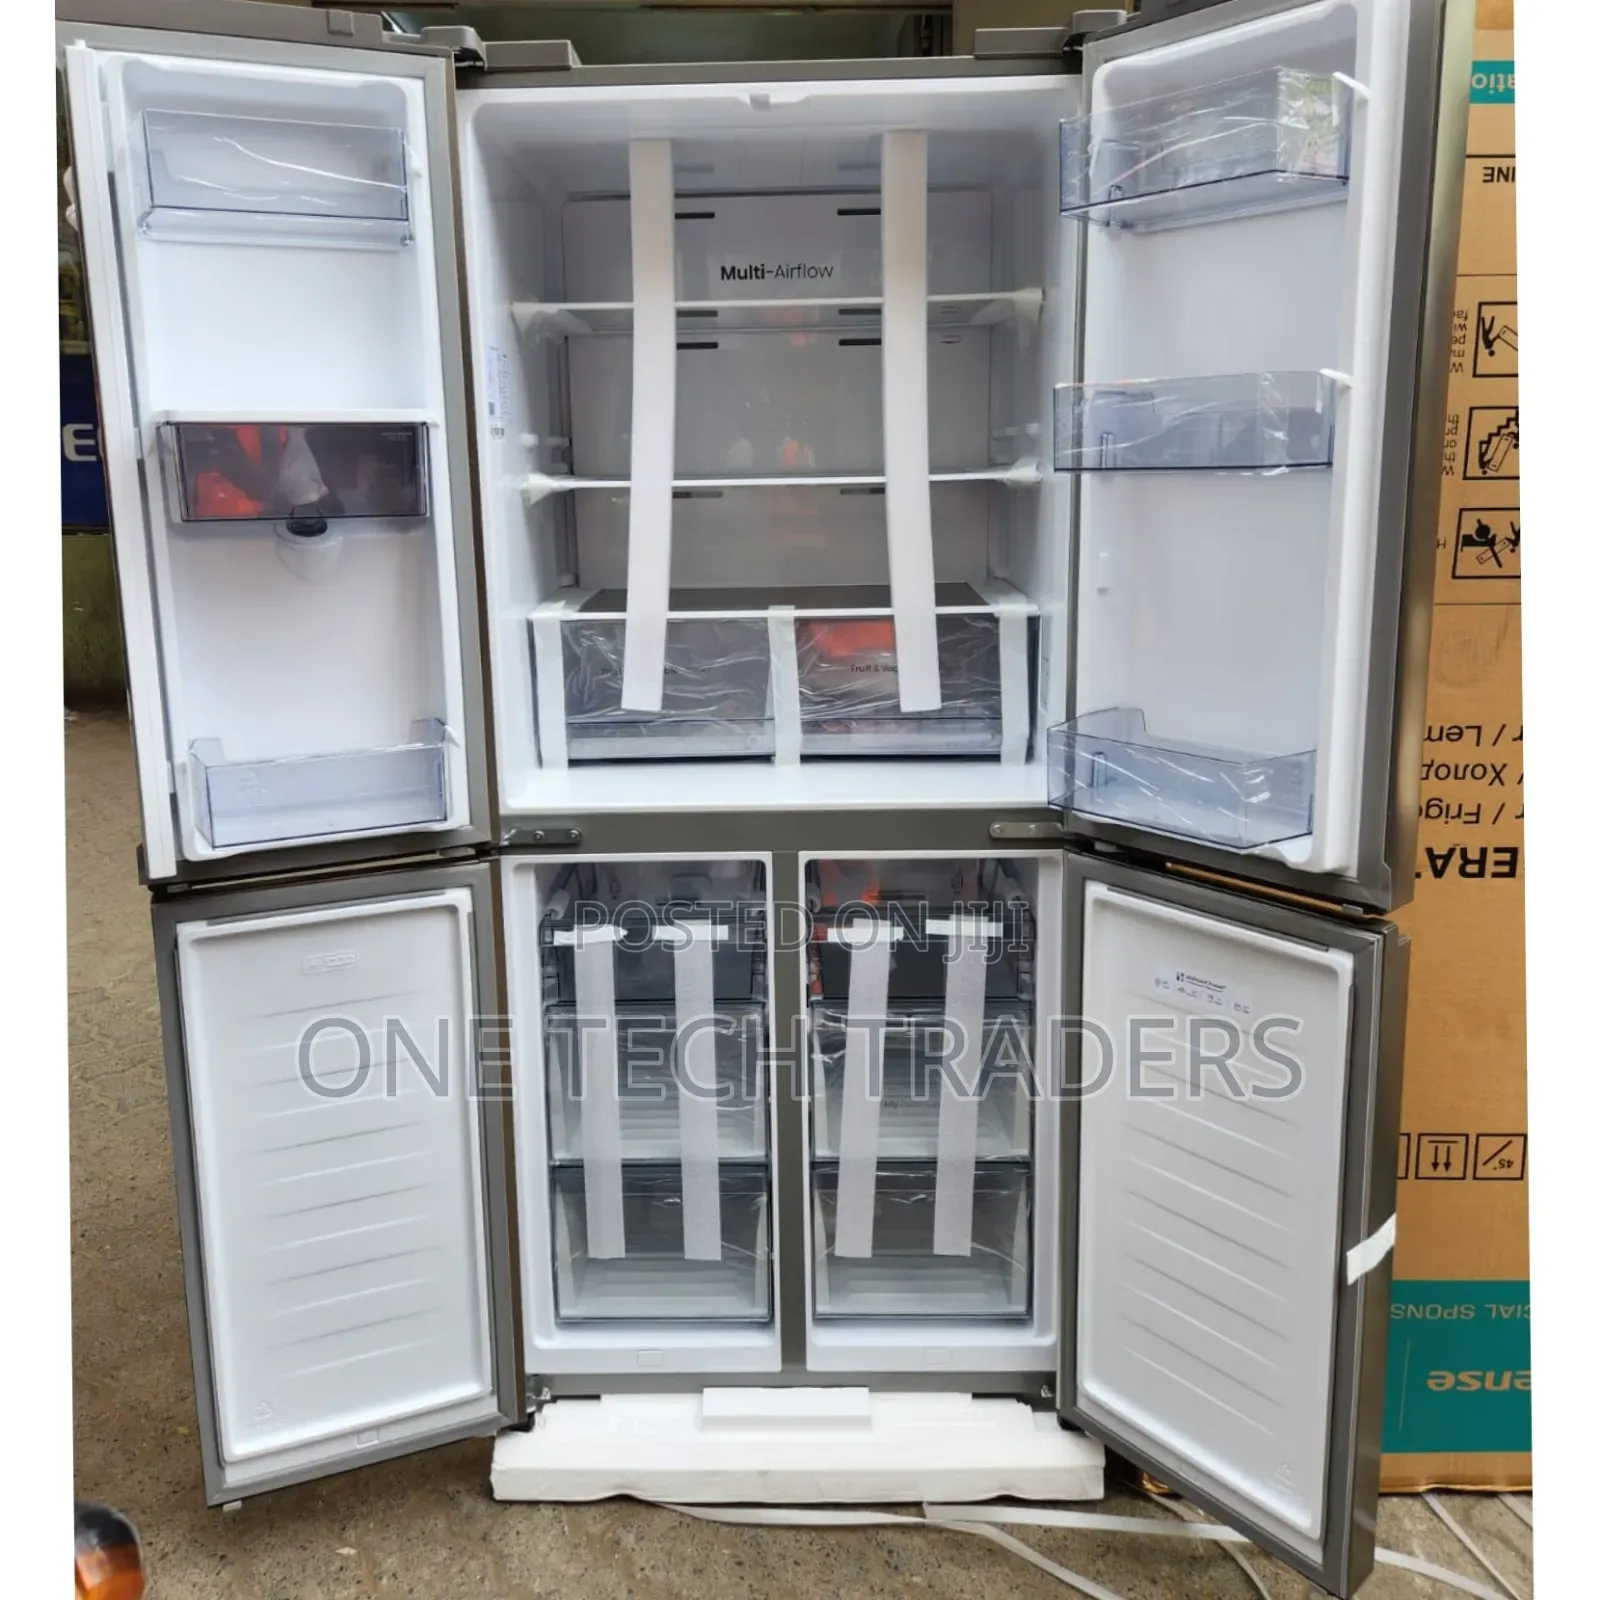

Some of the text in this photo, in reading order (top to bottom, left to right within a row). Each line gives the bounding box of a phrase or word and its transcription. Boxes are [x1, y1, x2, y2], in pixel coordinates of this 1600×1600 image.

[720, 262, 835, 282] Multi-Airflow
[1450, 349, 1465, 358] m
[62, 422, 103, 463] E
